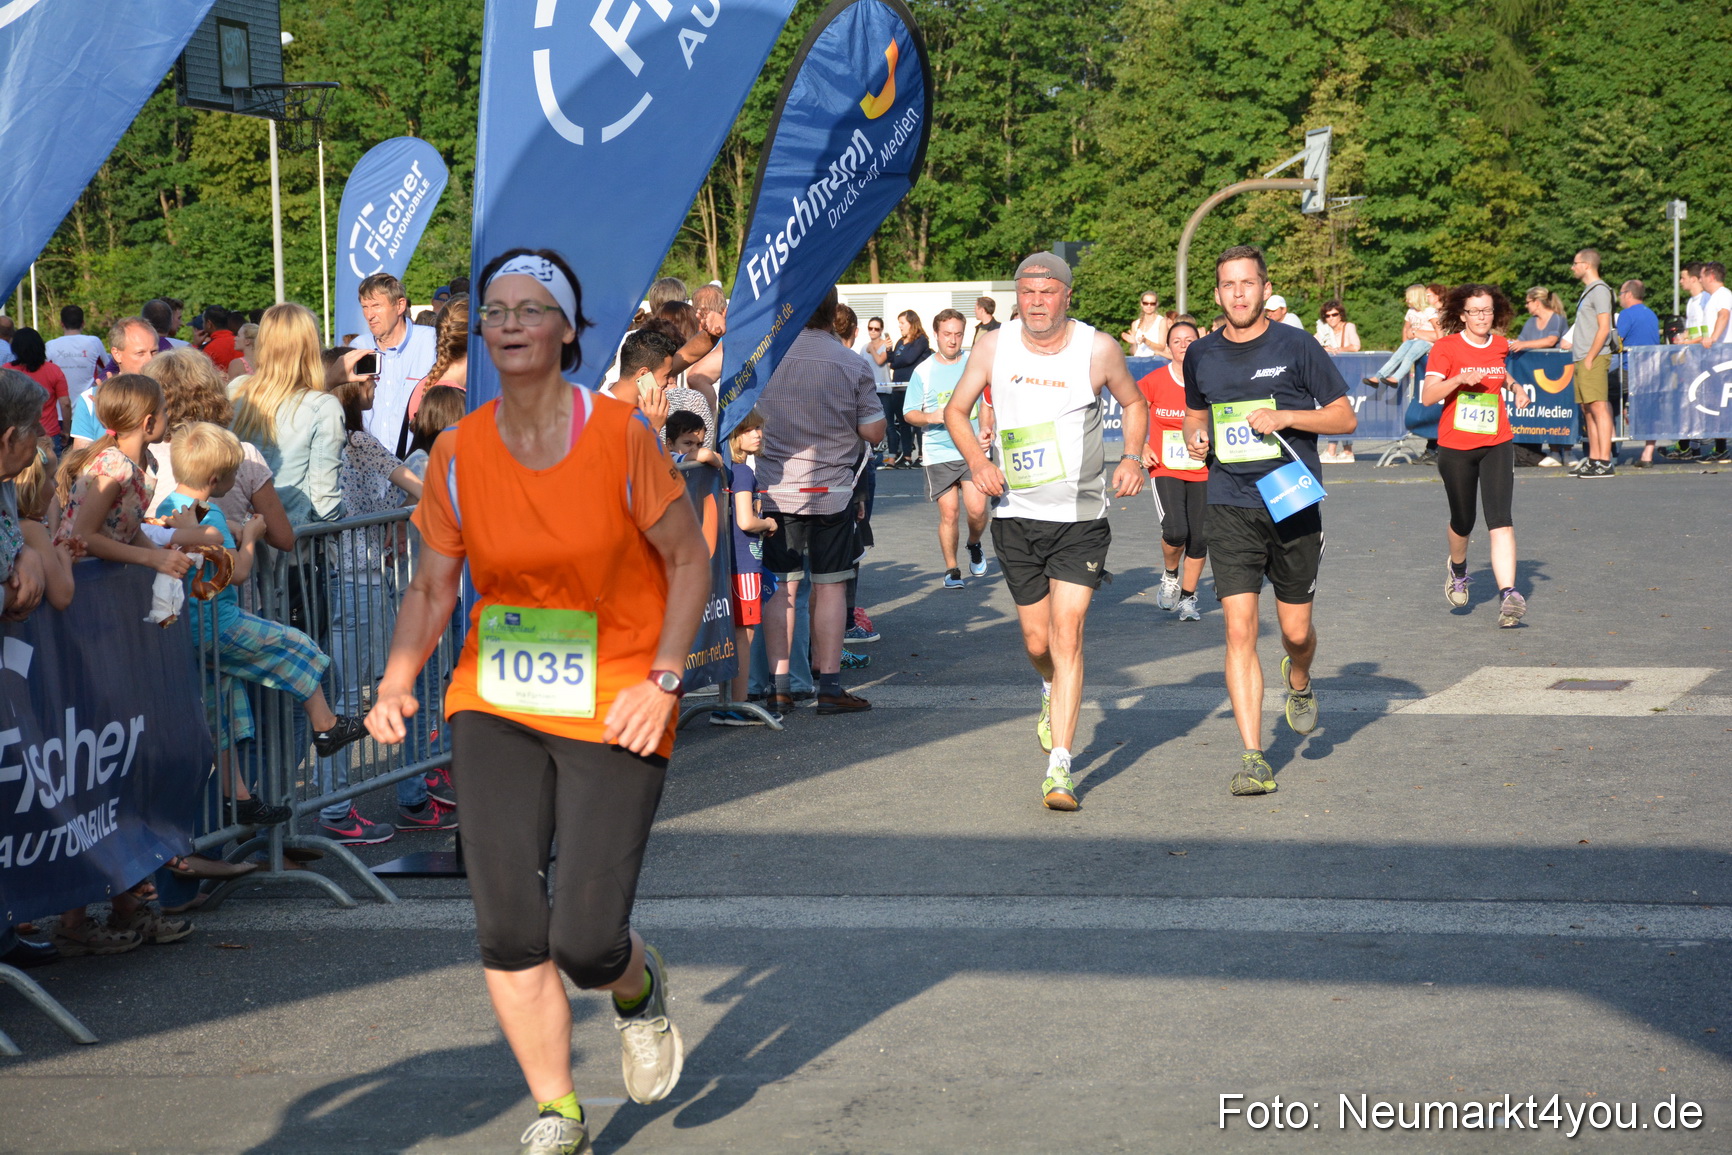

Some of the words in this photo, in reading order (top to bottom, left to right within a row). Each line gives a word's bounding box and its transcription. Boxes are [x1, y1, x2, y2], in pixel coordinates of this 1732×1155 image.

[827, 182, 861, 230] Druck
[880, 107, 920, 168] Medien
[363, 159, 423, 262] Fischer
[387, 178, 431, 259] AUTOMOBILE
[746, 128, 874, 301] Frischmann
[718, 302, 795, 414] ww.frischmann-net.de
[1155, 407, 1186, 418] NEUMA
[1460, 406, 1496, 424] 1413
[1515, 405, 1536, 418] und
[1536, 404, 1573, 419] Medien
[1225, 425, 1265, 446] 699
[1510, 424, 1571, 436] ischmann-net.de
[1011, 447, 1046, 472] 557
[1167, 446, 1191, 460] 14
[702, 593, 731, 623] edien
[490, 647, 585, 686] 1035
[685, 636, 735, 670] mann-net.de
